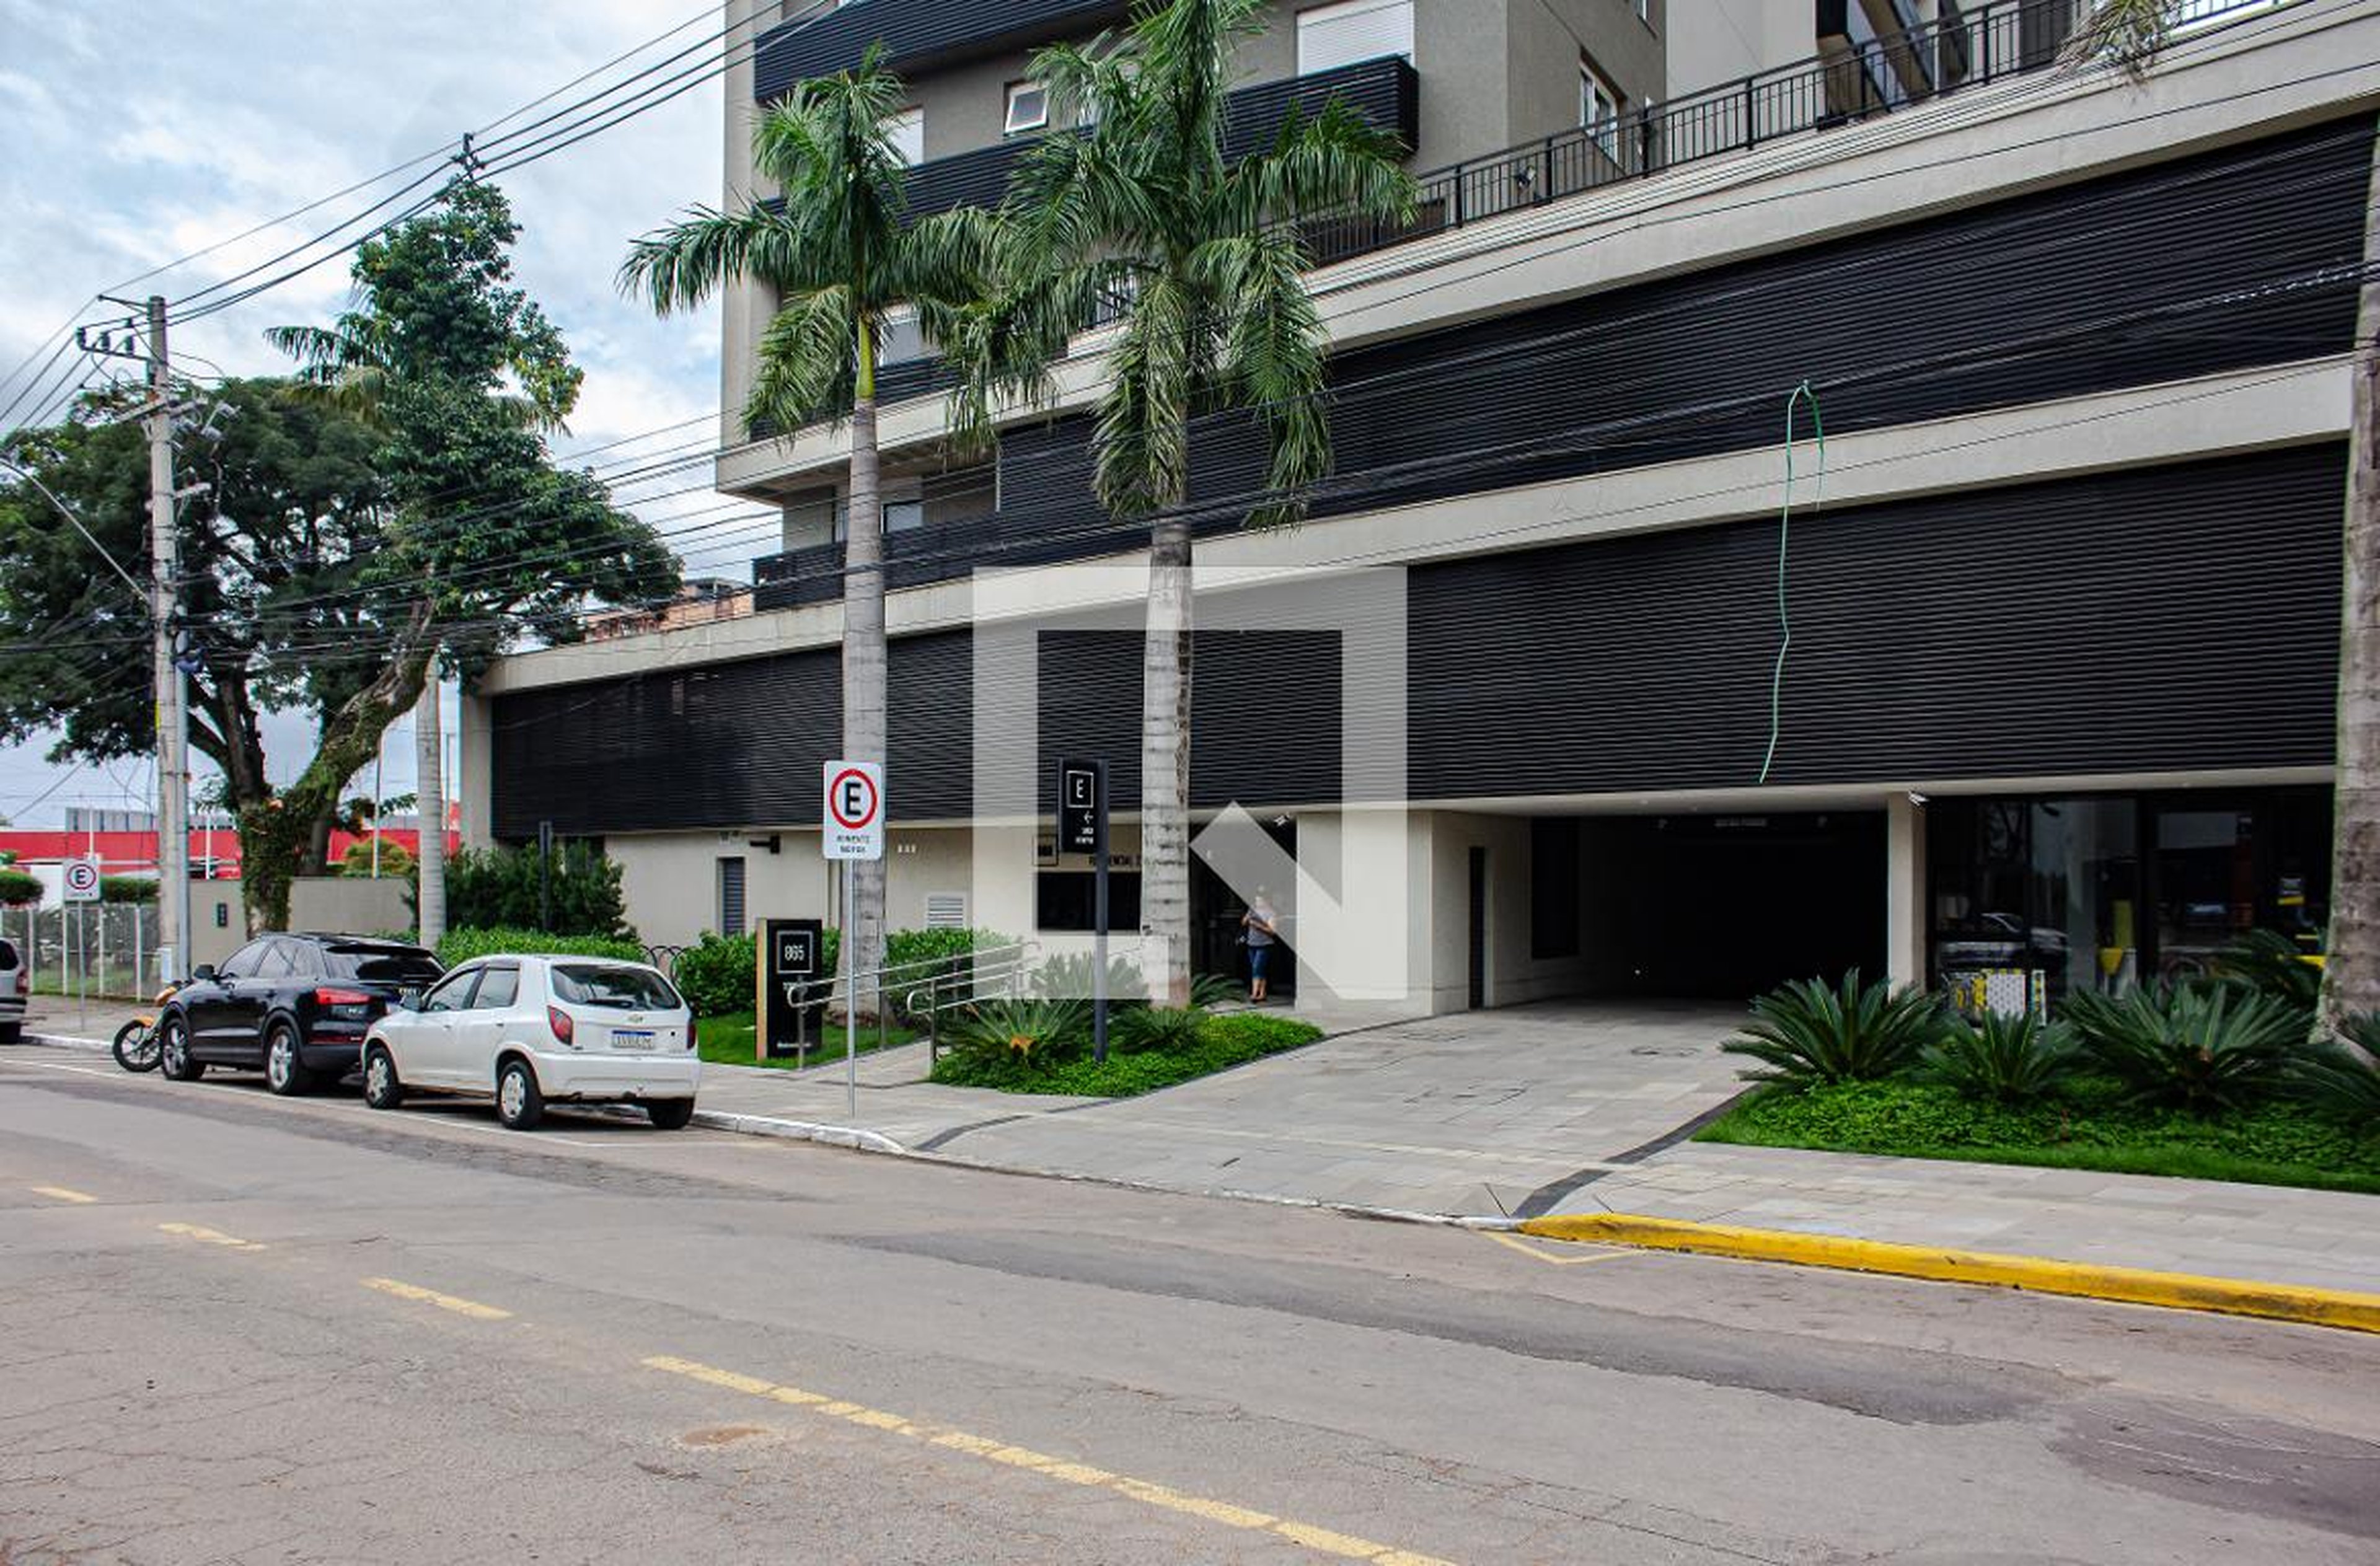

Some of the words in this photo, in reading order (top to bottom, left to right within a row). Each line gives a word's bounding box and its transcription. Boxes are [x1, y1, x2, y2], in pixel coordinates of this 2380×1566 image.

[1076, 778, 1084, 798] E
[845, 783, 862, 816] E
[76, 869, 86, 885] E
[785, 945, 804, 961] 865
